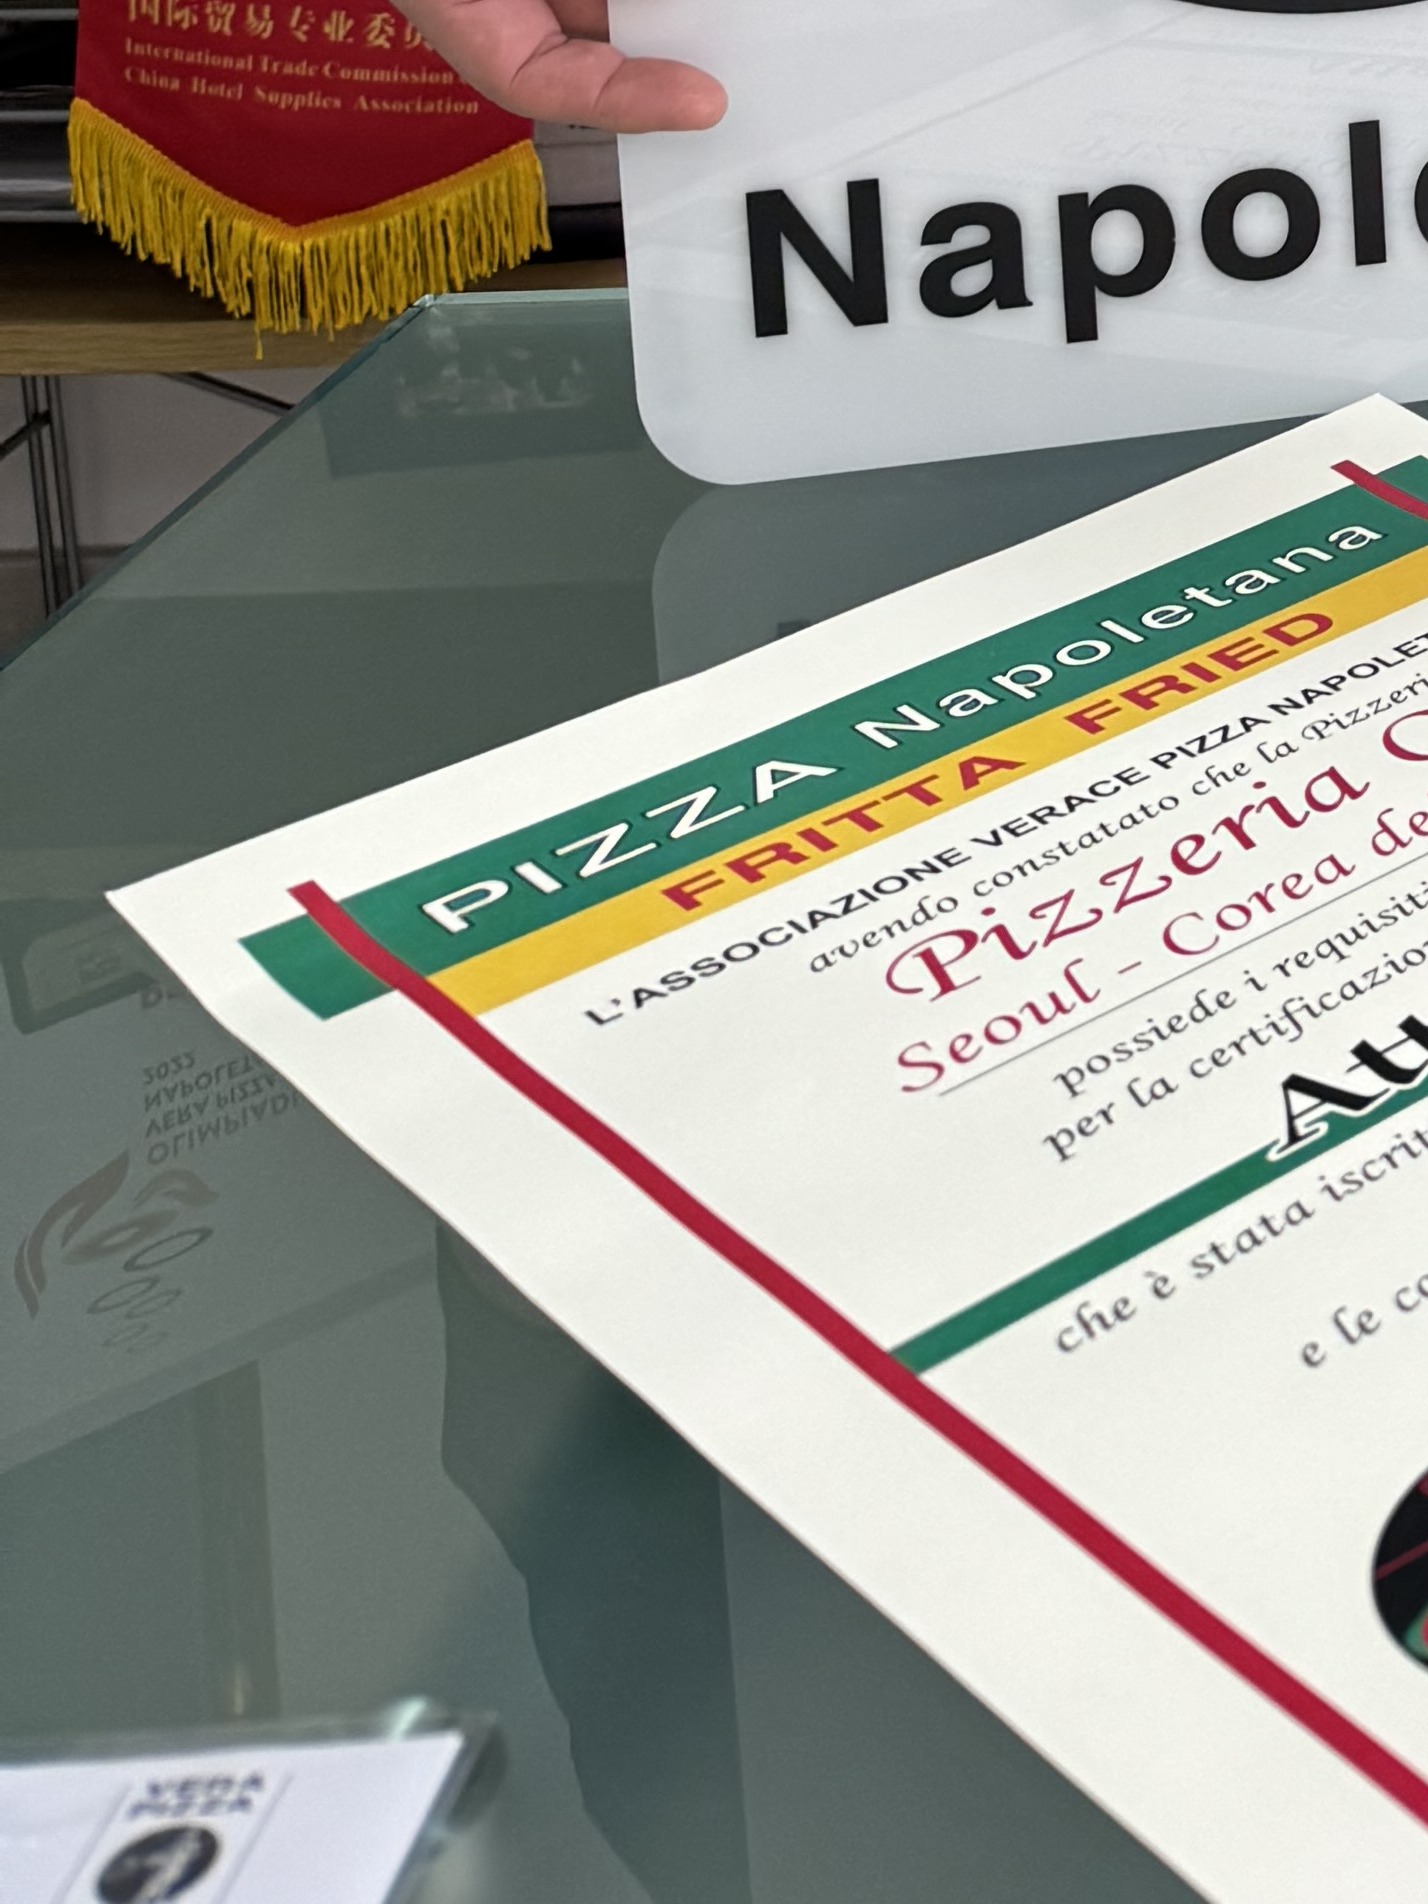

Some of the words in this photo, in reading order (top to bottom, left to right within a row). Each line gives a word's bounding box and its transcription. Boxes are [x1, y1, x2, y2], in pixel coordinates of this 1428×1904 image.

[124, 36, 253, 73] International
[258, 55, 322, 78] Trade
[323, 61, 457, 85] Commission
[124, 66, 182, 92] China
[190, 75, 244, 102] Hotel
[253, 85, 343, 112] Supplies
[353, 94, 480, 116] Association
[421, 759, 837, 933] PIZZA
[854, 524, 1382, 749] Napoletana
[660, 754, 1025, 912] FRITTA
[1063, 611, 1334, 735] FRIED
[583, 846, 972, 1026] L'ASSOCIAZIONE
[968, 765, 1152, 848] VERACE
[1148, 714, 1272, 770] PIZZA
[808, 894, 959, 974] avendo
[972, 794, 1180, 898] constatato
[1190, 761, 1252, 796] che
[1255, 740, 1300, 765] la
[884, 764, 1371, 1002] Pizzeria
[896, 956, 1101, 1093] Seoul
[1160, 852, 1356, 956] Corea
[1052, 987, 1237, 1099] possiede
[1041, 1101, 1115, 1163] per
[1125, 1075, 1179, 1109] la
[1055, 1295, 1136, 1354] che
[1189, 1198, 1315, 1280] stata
[1331, 1305, 1381, 1346] le
